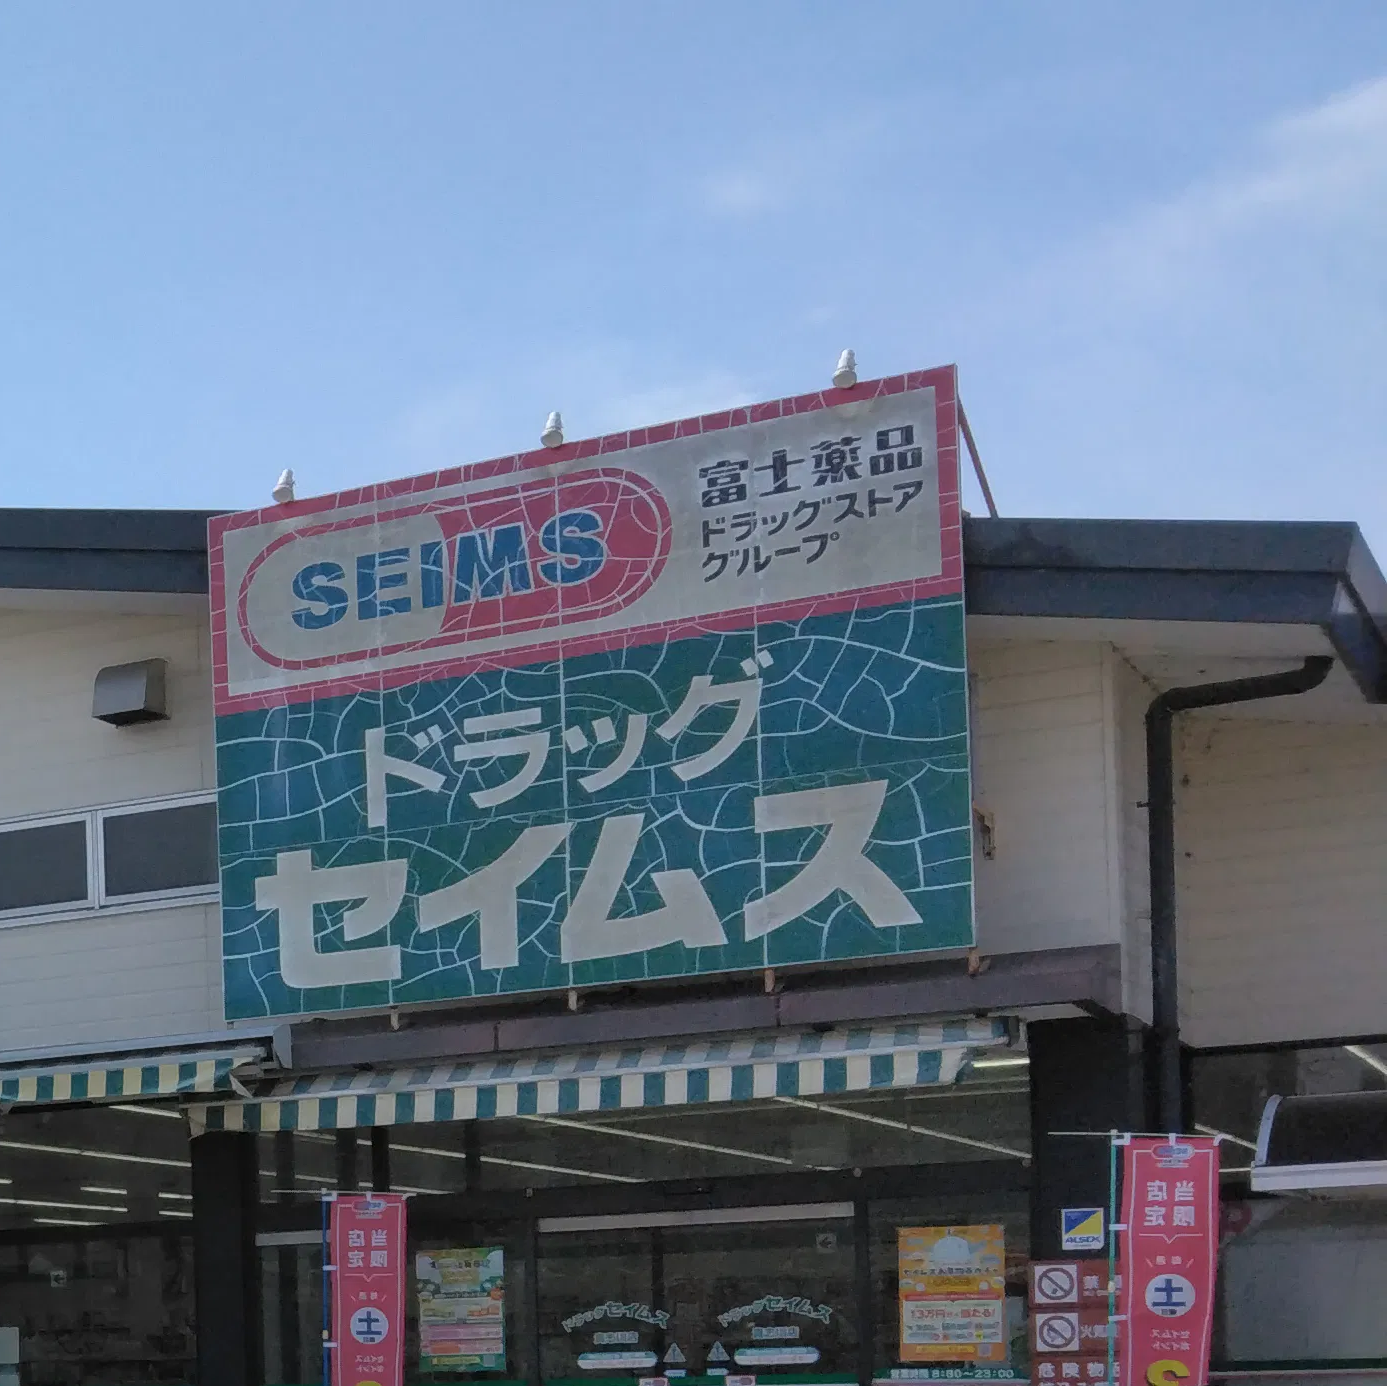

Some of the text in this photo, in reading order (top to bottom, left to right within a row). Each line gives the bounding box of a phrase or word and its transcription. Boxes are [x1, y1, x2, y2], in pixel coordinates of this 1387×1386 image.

[699, 425, 923, 508] 富士薬品
[702, 480, 924, 548] ドラッグストア
[291, 510, 605, 630] SEIMS
[702, 531, 841, 582] グループ
[365, 649, 774, 827] ドラッグ
[255, 779, 924, 989] セイムス
